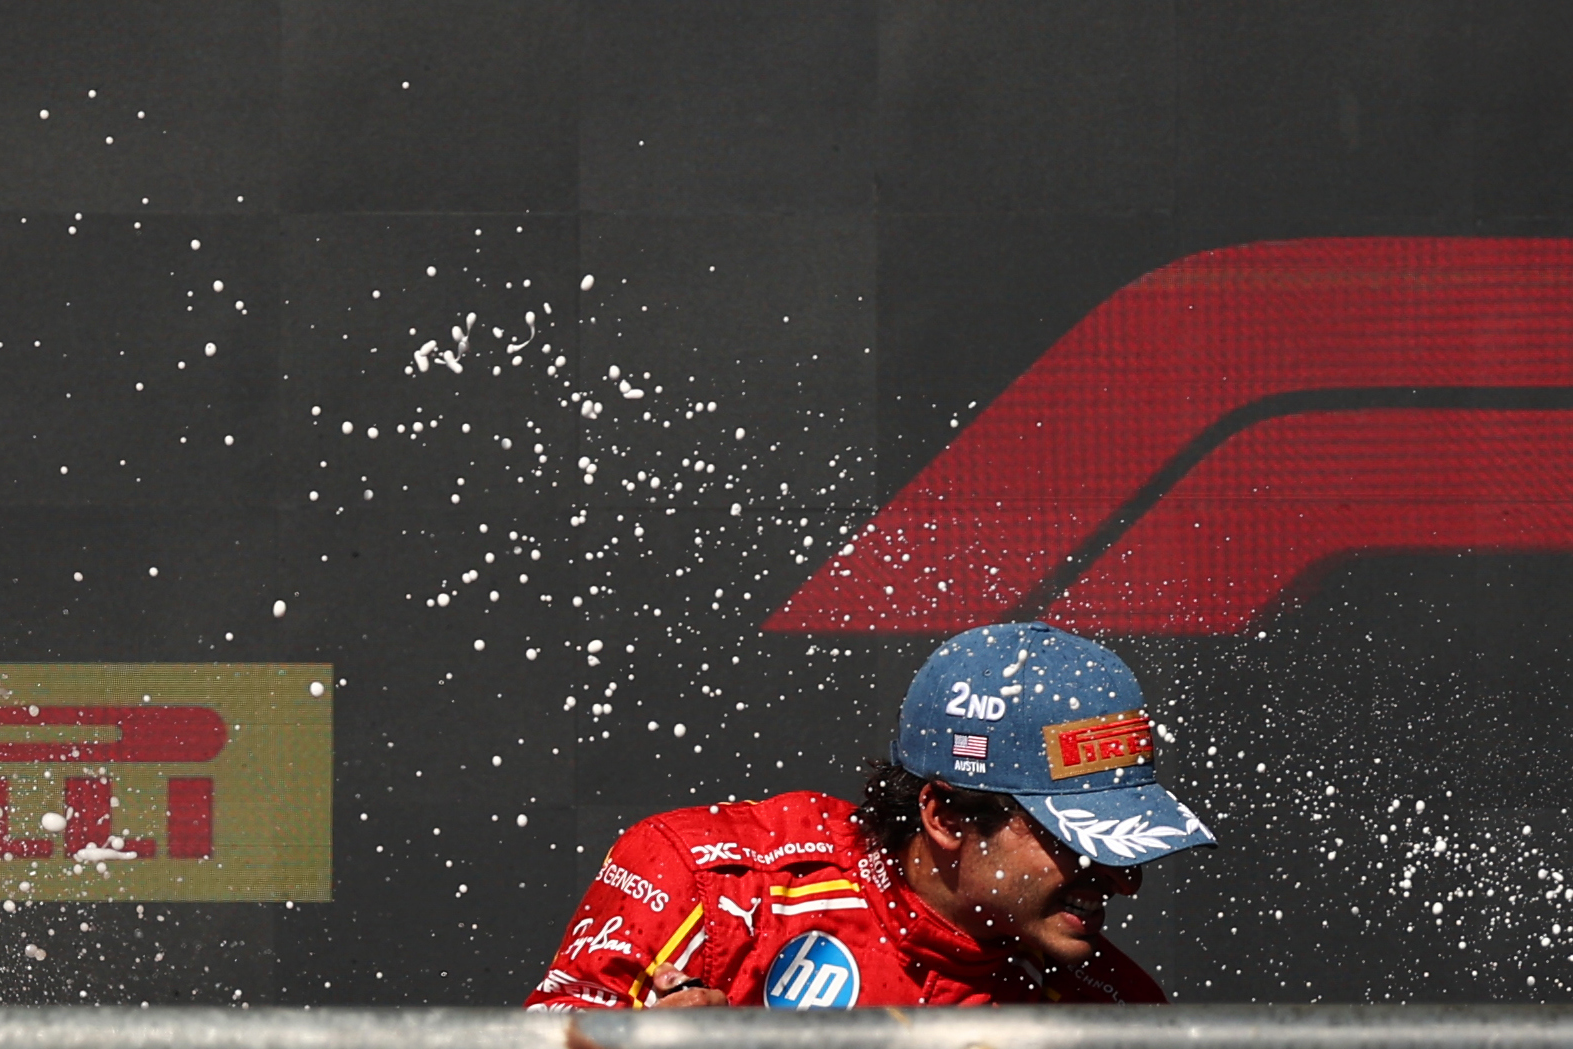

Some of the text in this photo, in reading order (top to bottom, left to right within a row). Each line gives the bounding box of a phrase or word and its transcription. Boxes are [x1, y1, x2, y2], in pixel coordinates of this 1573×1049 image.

[946, 681, 1006, 721] 2ND
[1059, 717, 1153, 767] PIRE
[954, 760, 987, 774] AUSTIN
[690, 842, 834, 865] DXC TECHNOLOGY
[872, 851, 892, 890] RONI
[603, 864, 670, 913] GENESYS
[770, 931, 850, 1011] hp
